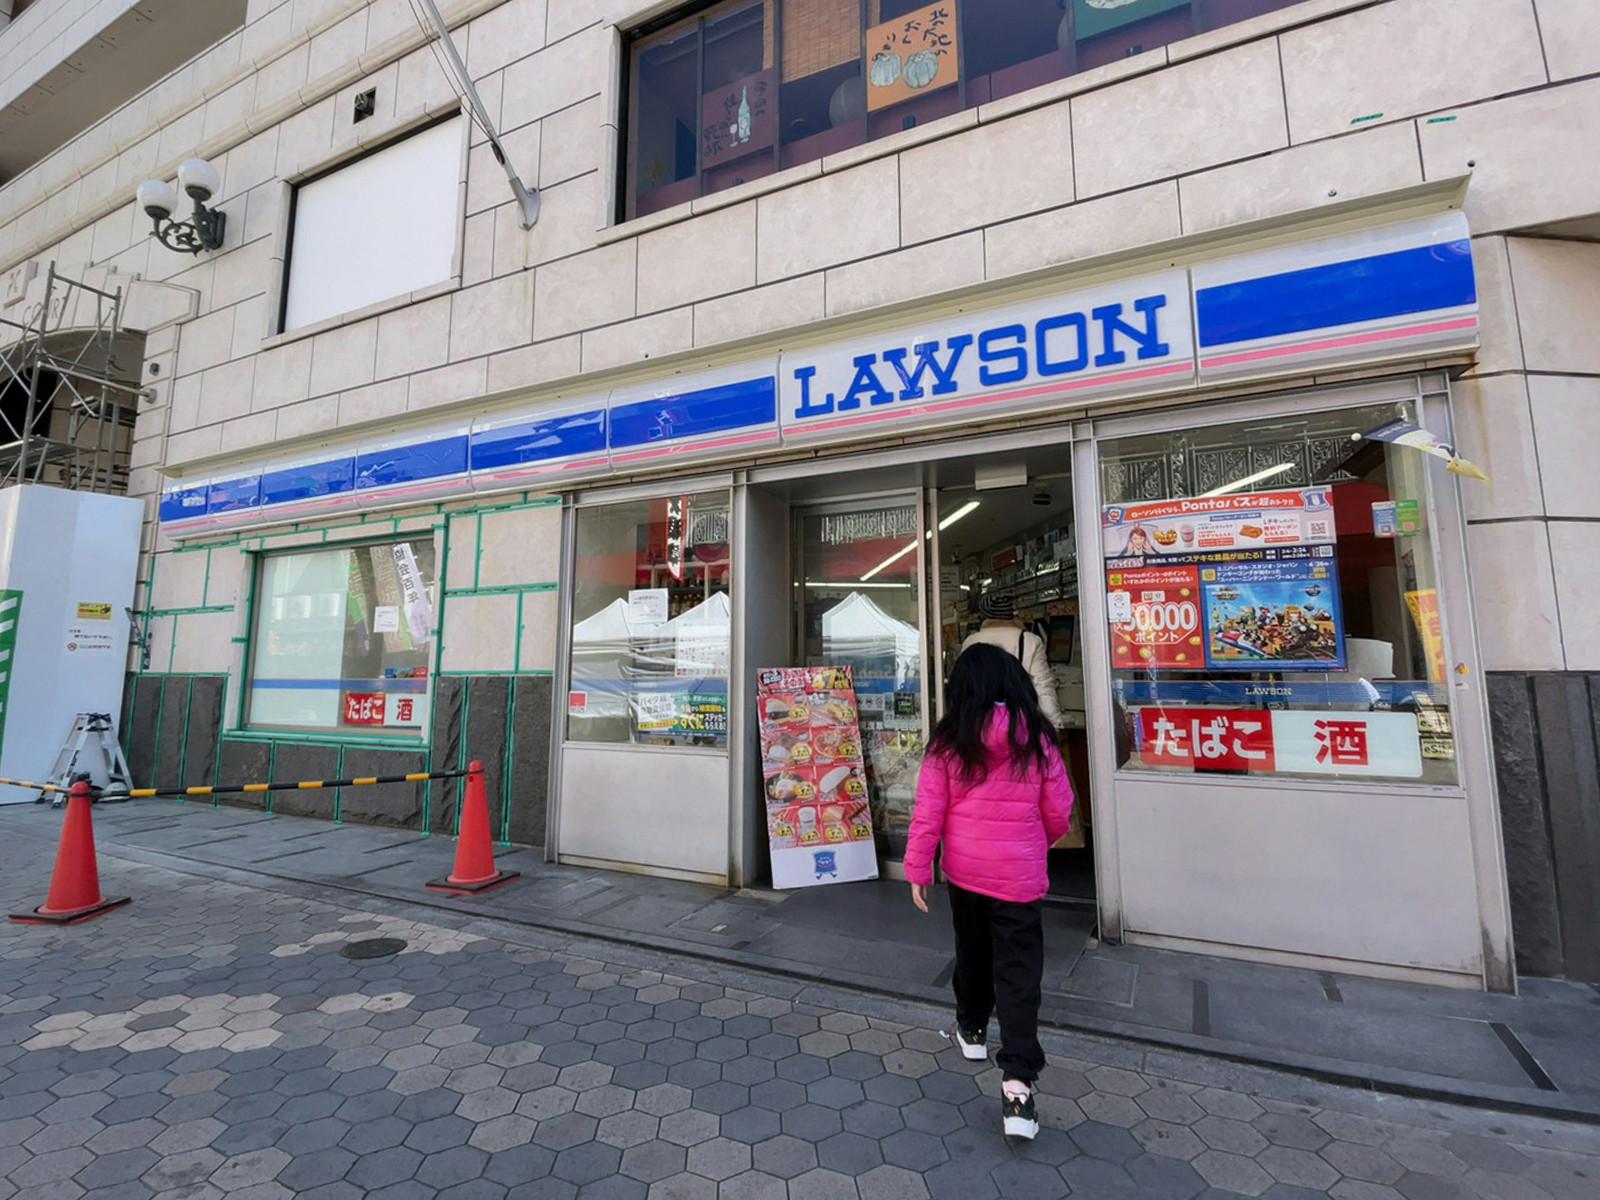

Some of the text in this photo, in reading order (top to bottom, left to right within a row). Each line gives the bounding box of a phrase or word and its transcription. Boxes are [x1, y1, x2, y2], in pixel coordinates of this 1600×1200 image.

[794, 294, 1170, 418] LAWSON
[1135, 631, 1179, 643] ポイント
[1245, 687, 1292, 695] LAWSON
[347, 698, 414, 721] たばこ 酒
[1153, 716, 1368, 765] たばこ 酒
